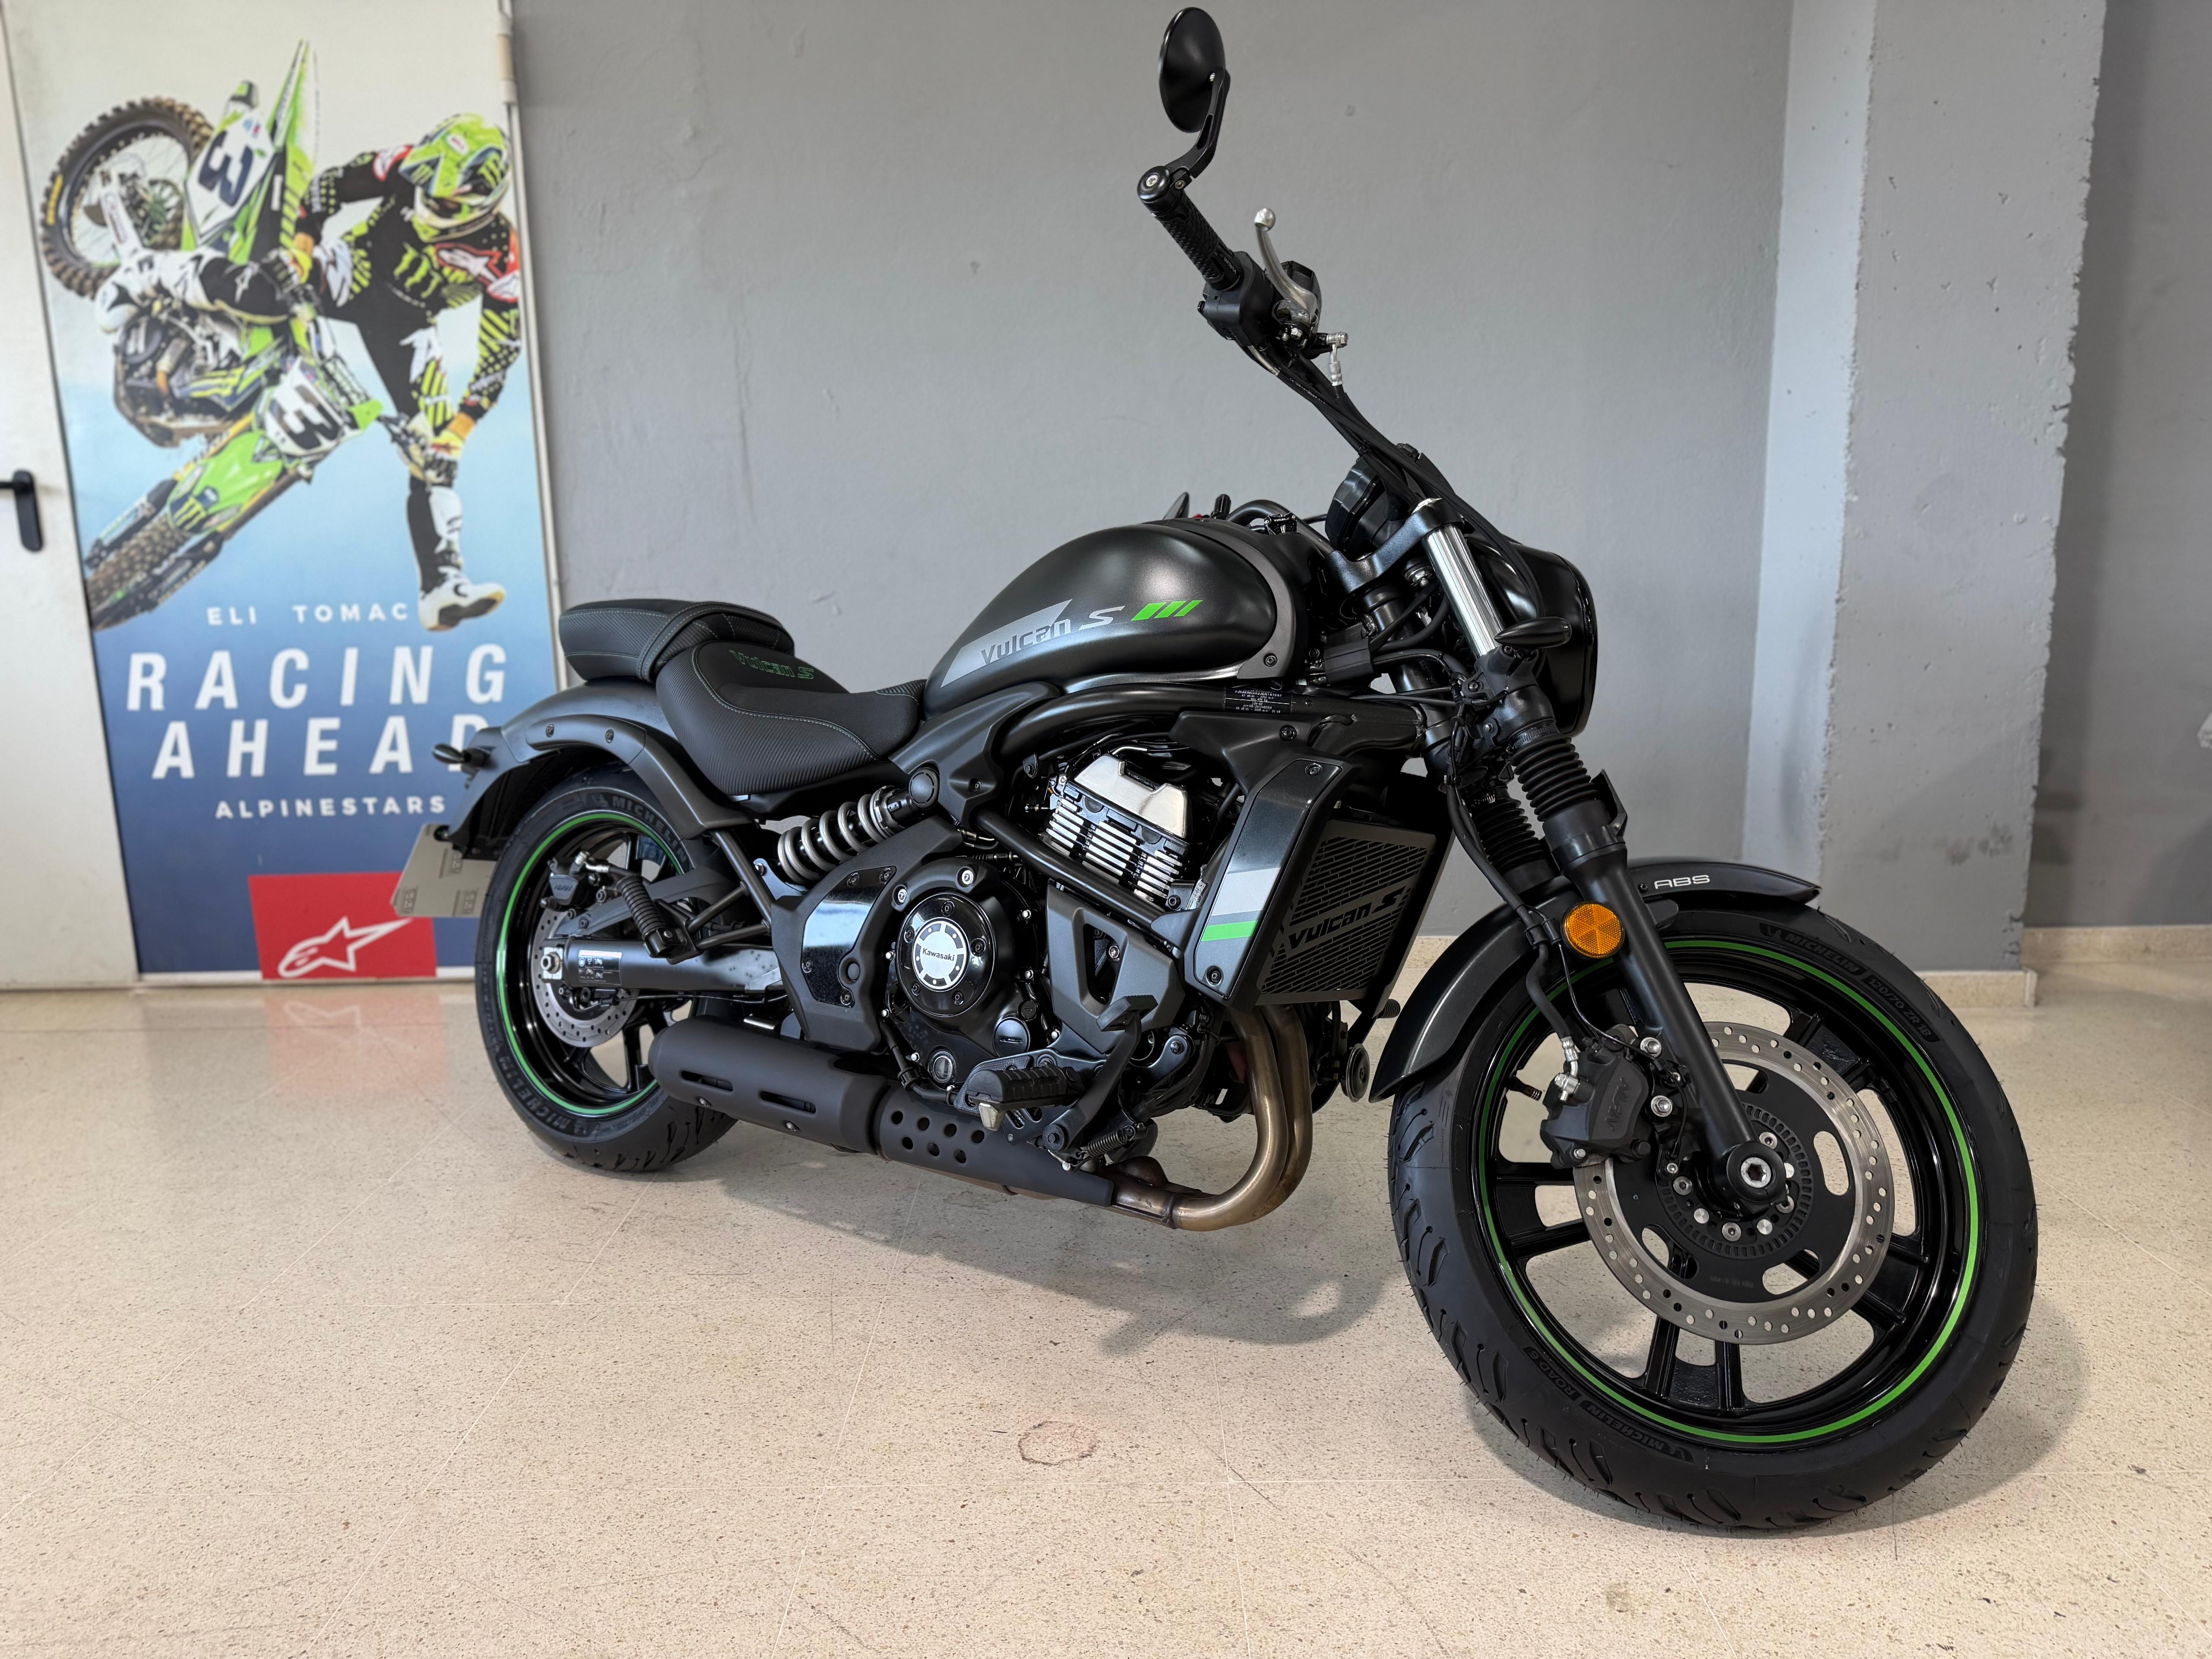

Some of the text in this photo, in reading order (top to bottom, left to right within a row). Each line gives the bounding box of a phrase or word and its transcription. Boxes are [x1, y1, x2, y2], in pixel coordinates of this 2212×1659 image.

[206, 603, 408, 626] ELI TOMAC
[981, 605, 1125, 664] Vulcan S
[127, 644, 506, 711] RACING
[729, 650, 814, 679] Vulcan S
[215, 796, 445, 818] ALPINESTARS
[612, 795, 688, 862] MICHELIN
[1654, 874, 1710, 890] ABS
[1288, 885, 1407, 950] Vulcan S
[922, 947, 955, 961] Kawasaki
[1785, 934, 1859, 975] MICHELIN
[1868, 978, 1905, 1008] 120/70
[1539, 1362, 1576, 1396] ROAD
[1587, 1404, 1665, 1450] MICHELIN
